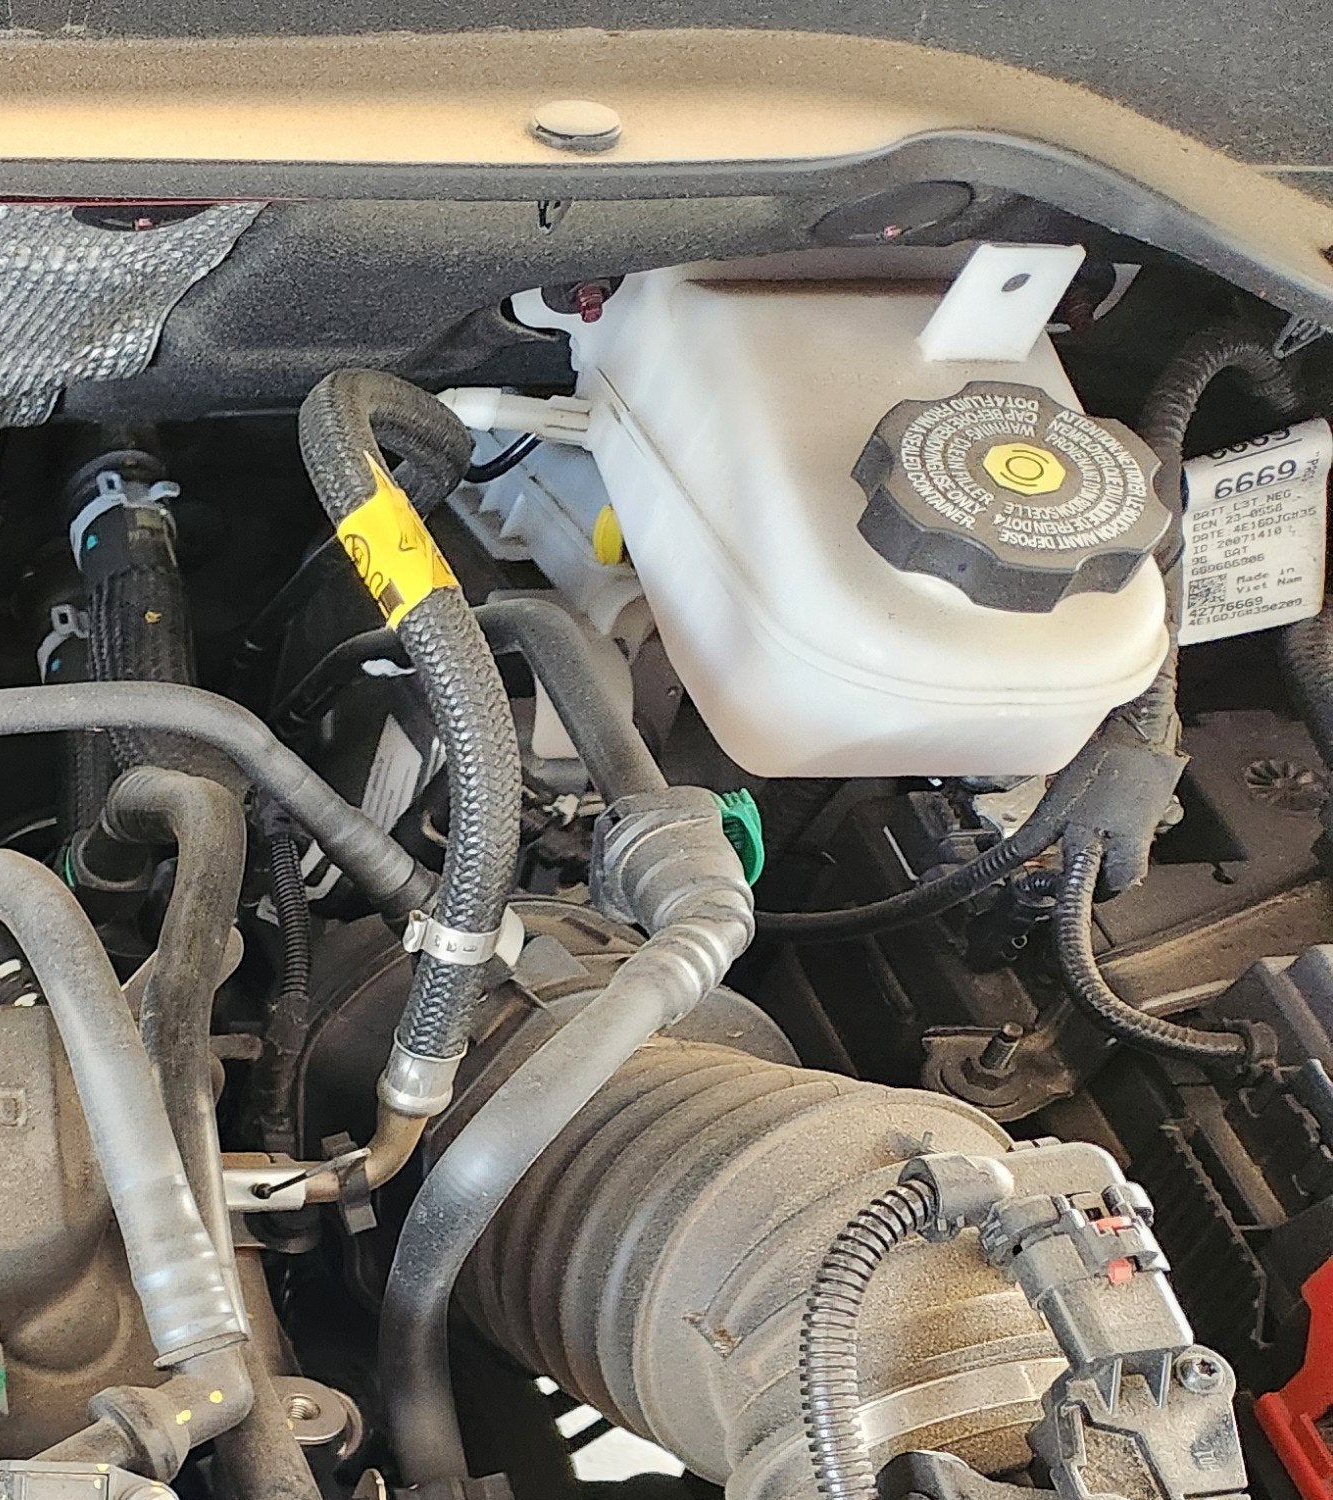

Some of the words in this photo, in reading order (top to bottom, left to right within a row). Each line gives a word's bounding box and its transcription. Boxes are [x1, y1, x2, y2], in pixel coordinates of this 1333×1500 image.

[950, 394, 994, 412] FLUID
[953, 408, 1005, 430] BEFORE
[1004, 408, 1038, 424] CAP
[952, 470, 995, 506] FILLER
[1214, 459, 1297, 499] 6669
[946, 489, 987, 516] ONLY
[1193, 520, 1217, 533] ECN
[1236, 572, 1270, 585] Made
[1279, 567, 1295, 575] in
[1236, 583, 1269, 595] Viet
[1277, 576, 1303, 586] Nam
